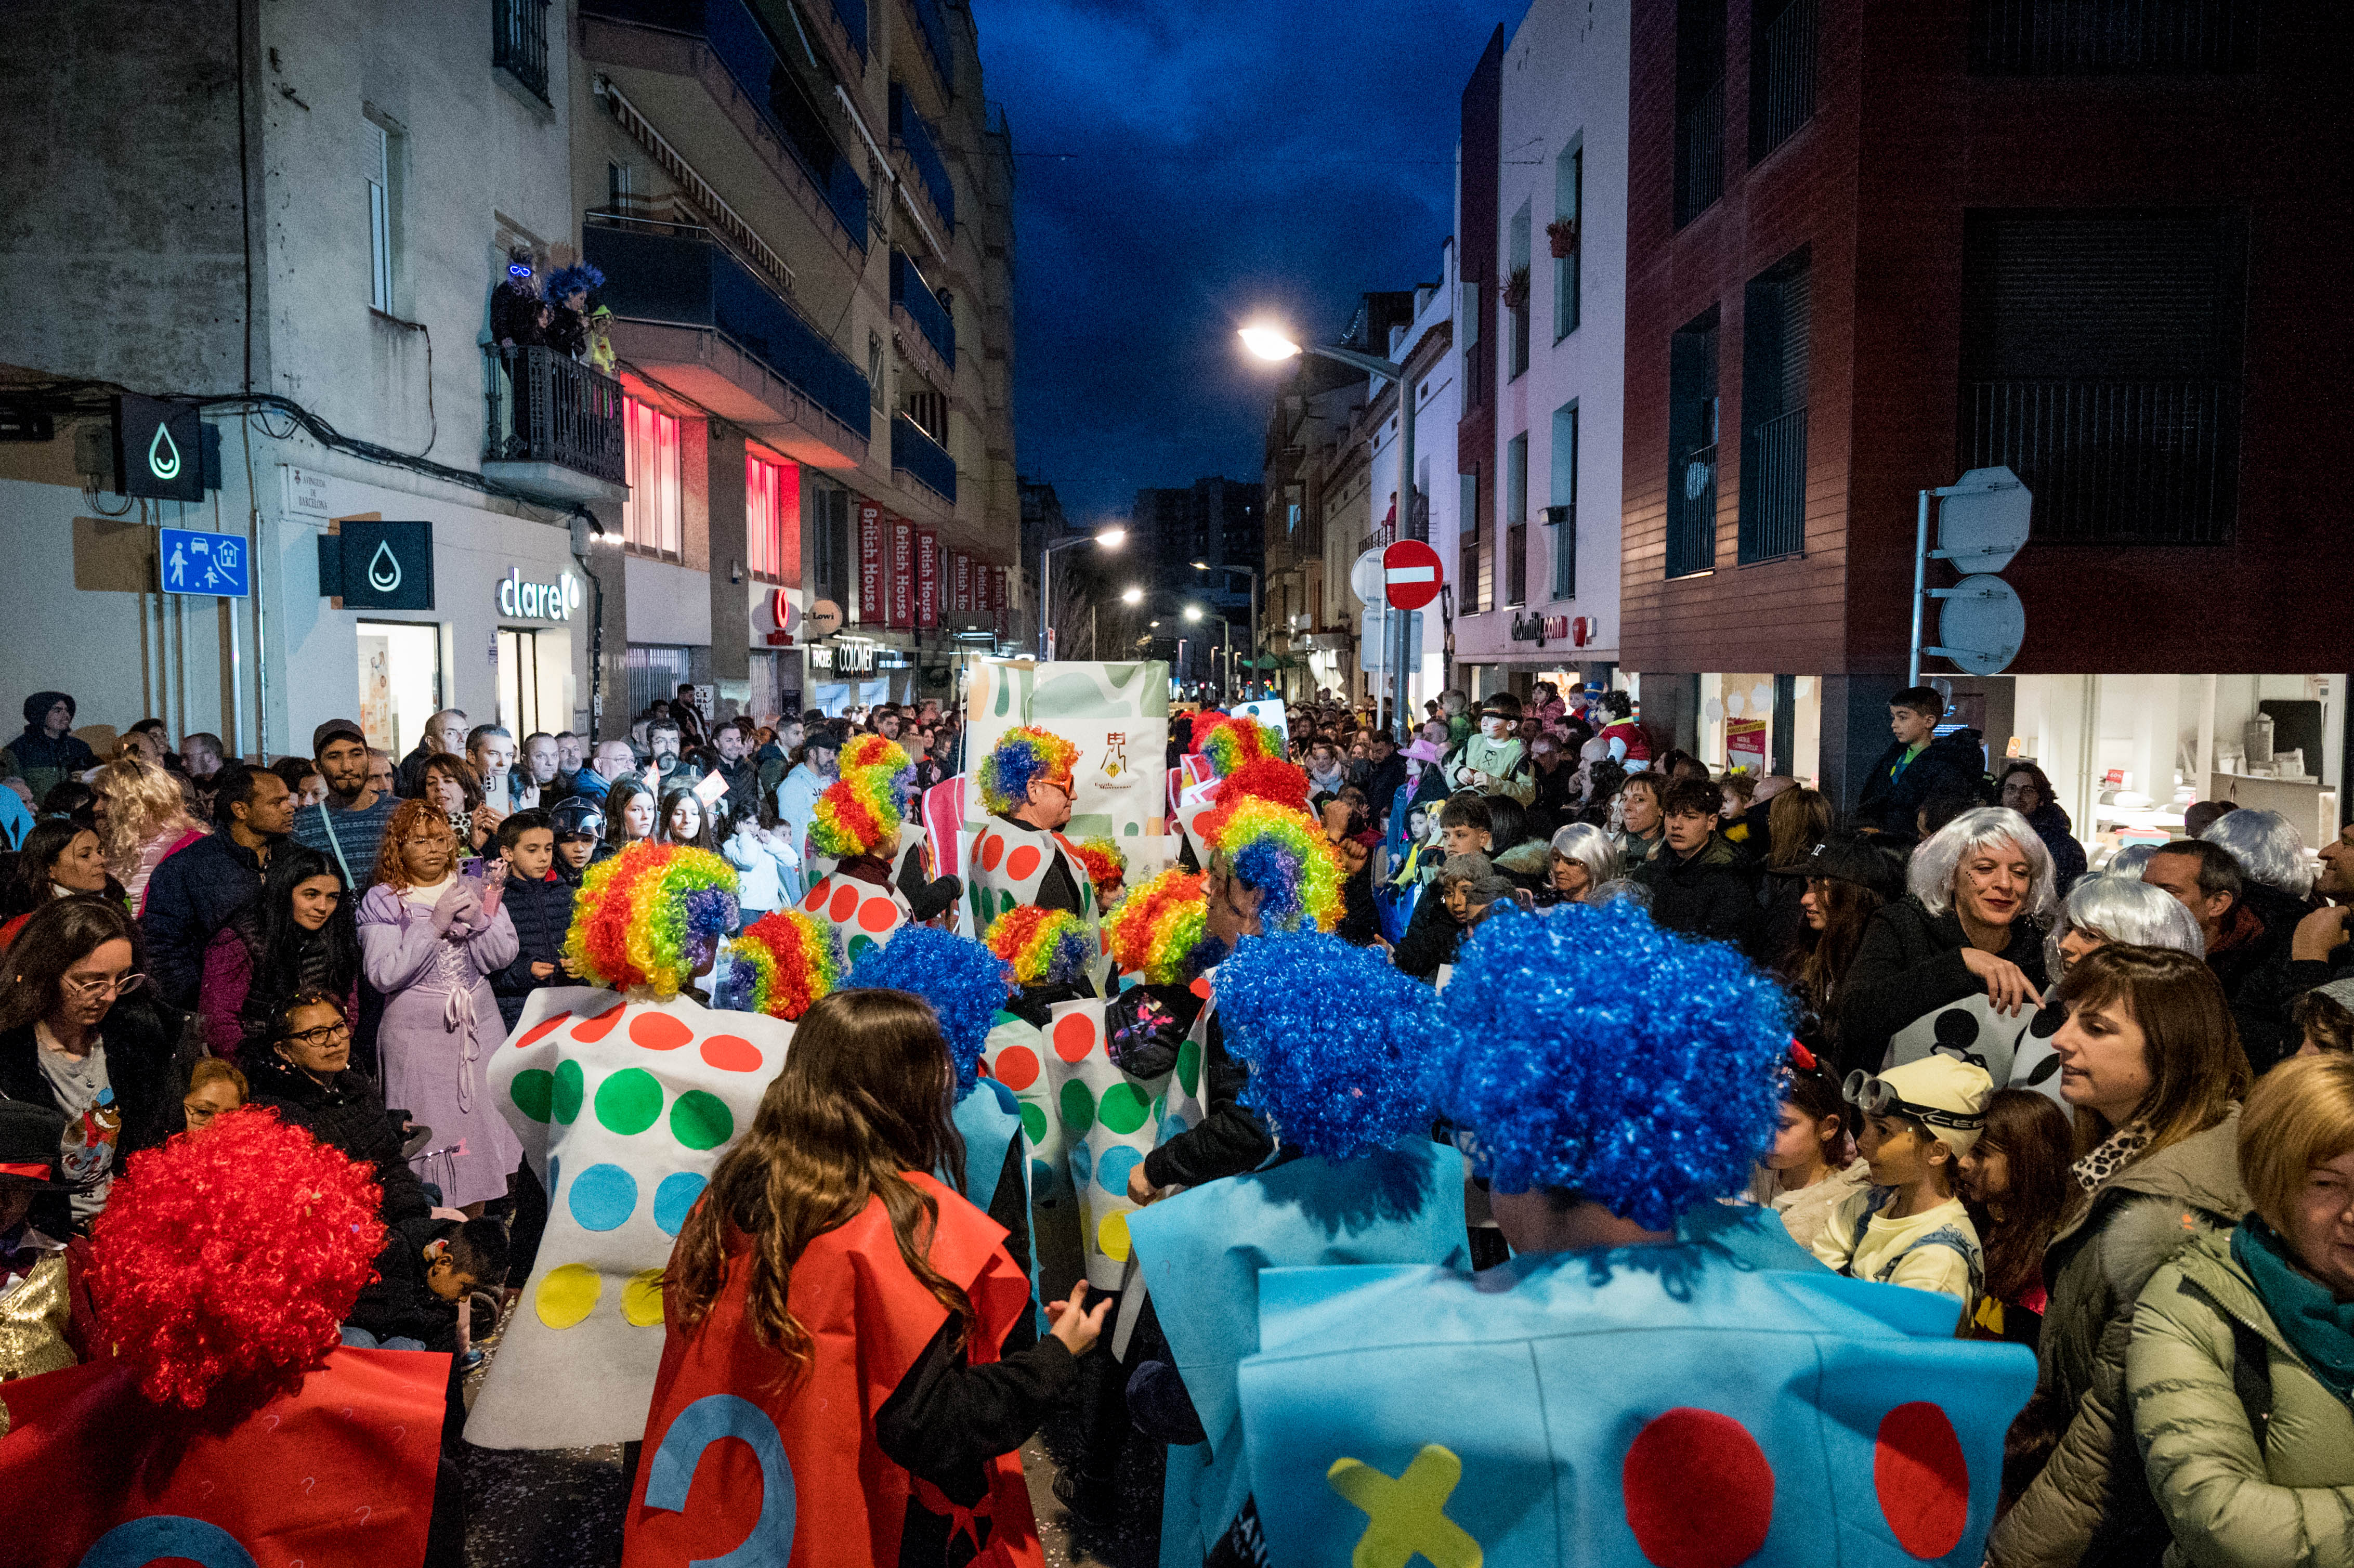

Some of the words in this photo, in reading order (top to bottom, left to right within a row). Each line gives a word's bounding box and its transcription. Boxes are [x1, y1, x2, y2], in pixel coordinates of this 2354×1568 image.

[299, 496, 328, 510] BARCELONA
[310, 489, 316, 497] DE
[864, 508, 878, 558] British
[896, 526, 909, 570] British
[921, 536, 933, 577] British
[958, 556, 967, 591] British
[498, 567, 569, 621] clarel
[865, 563, 878, 612] House
[896, 575, 909, 619] House
[922, 581, 933, 621] House
[978, 566, 987, 597] British
[840, 643, 873, 671] COLOMER
